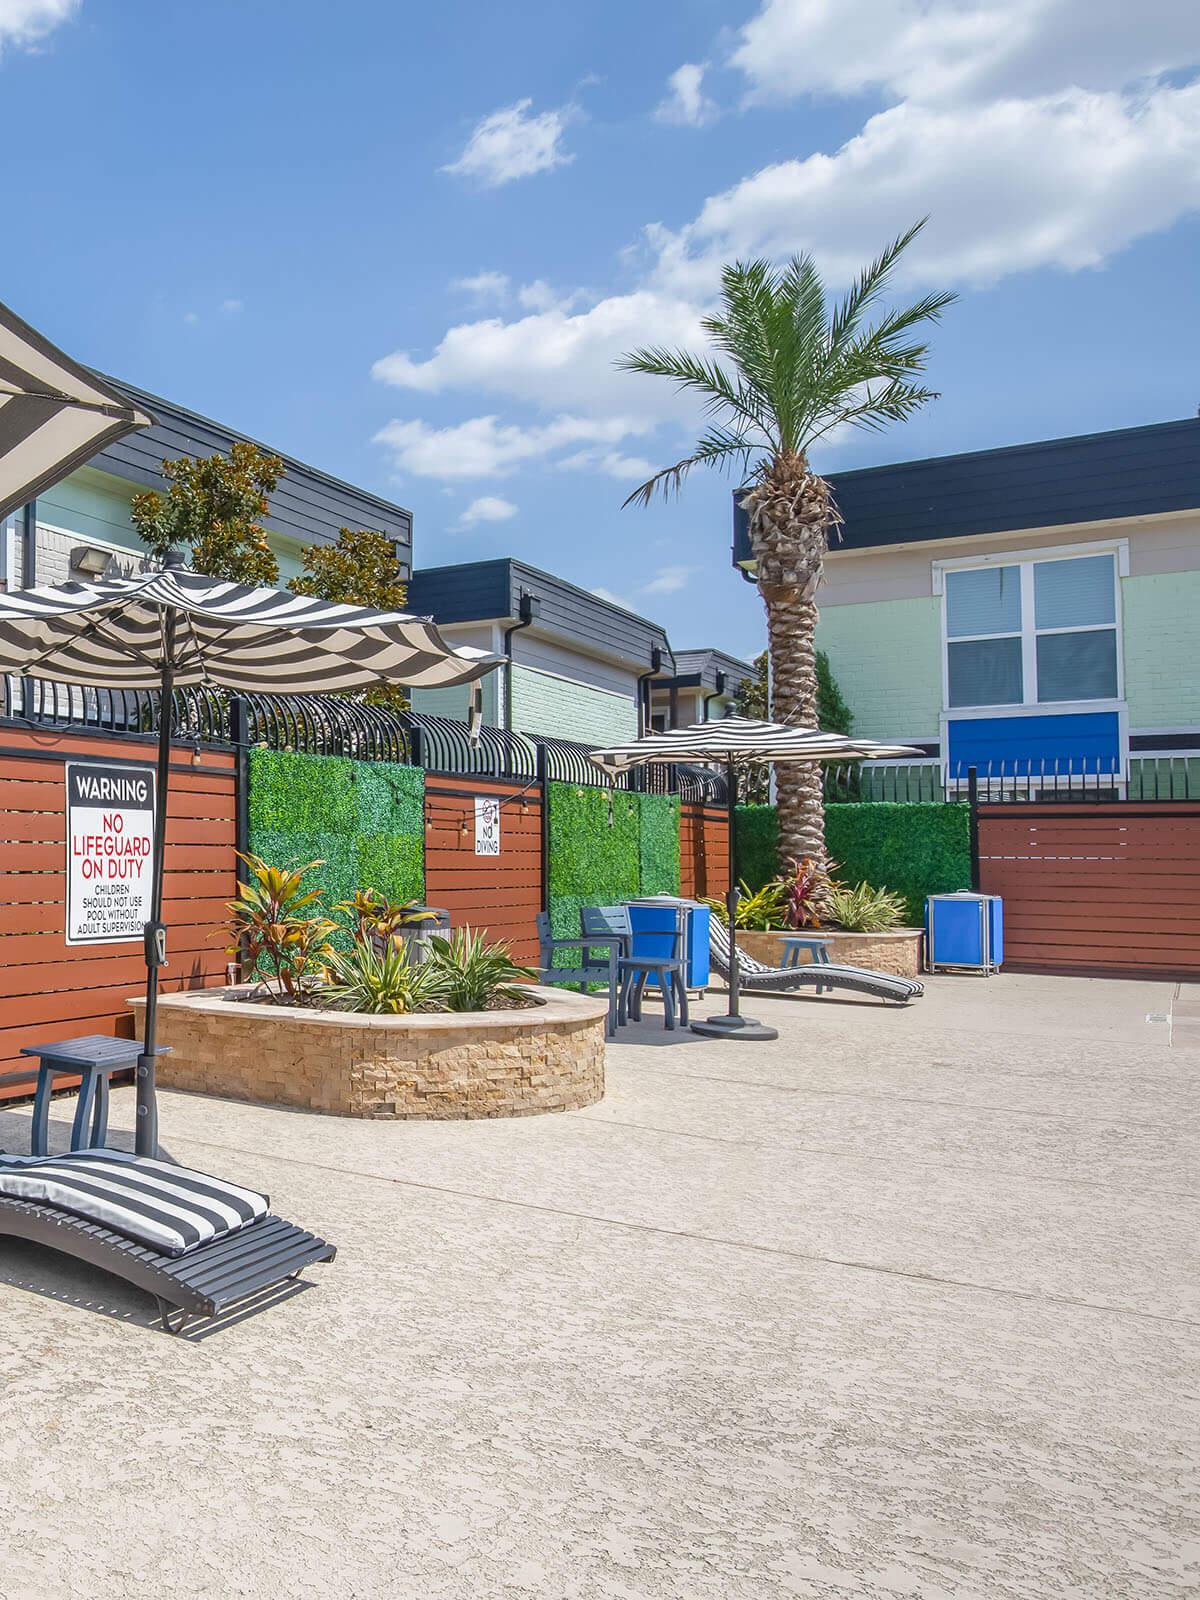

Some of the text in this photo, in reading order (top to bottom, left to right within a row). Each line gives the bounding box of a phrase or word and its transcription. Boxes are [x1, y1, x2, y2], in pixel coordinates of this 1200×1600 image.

[76, 775, 148, 802] WARNING
[103, 813, 123, 833] NO
[483, 826, 492, 839] NO
[73, 835, 151, 857] LIFEGUARD
[477, 840, 497, 853] DIVING
[81, 859, 144, 879] ON DUTY
[94, 884, 130, 895] CHILDREN
[82, 896, 142, 909] SHOULD NOT USE
[87, 909, 138, 921] POOL WITHOUT
[77, 922, 101, 935] ADULT
